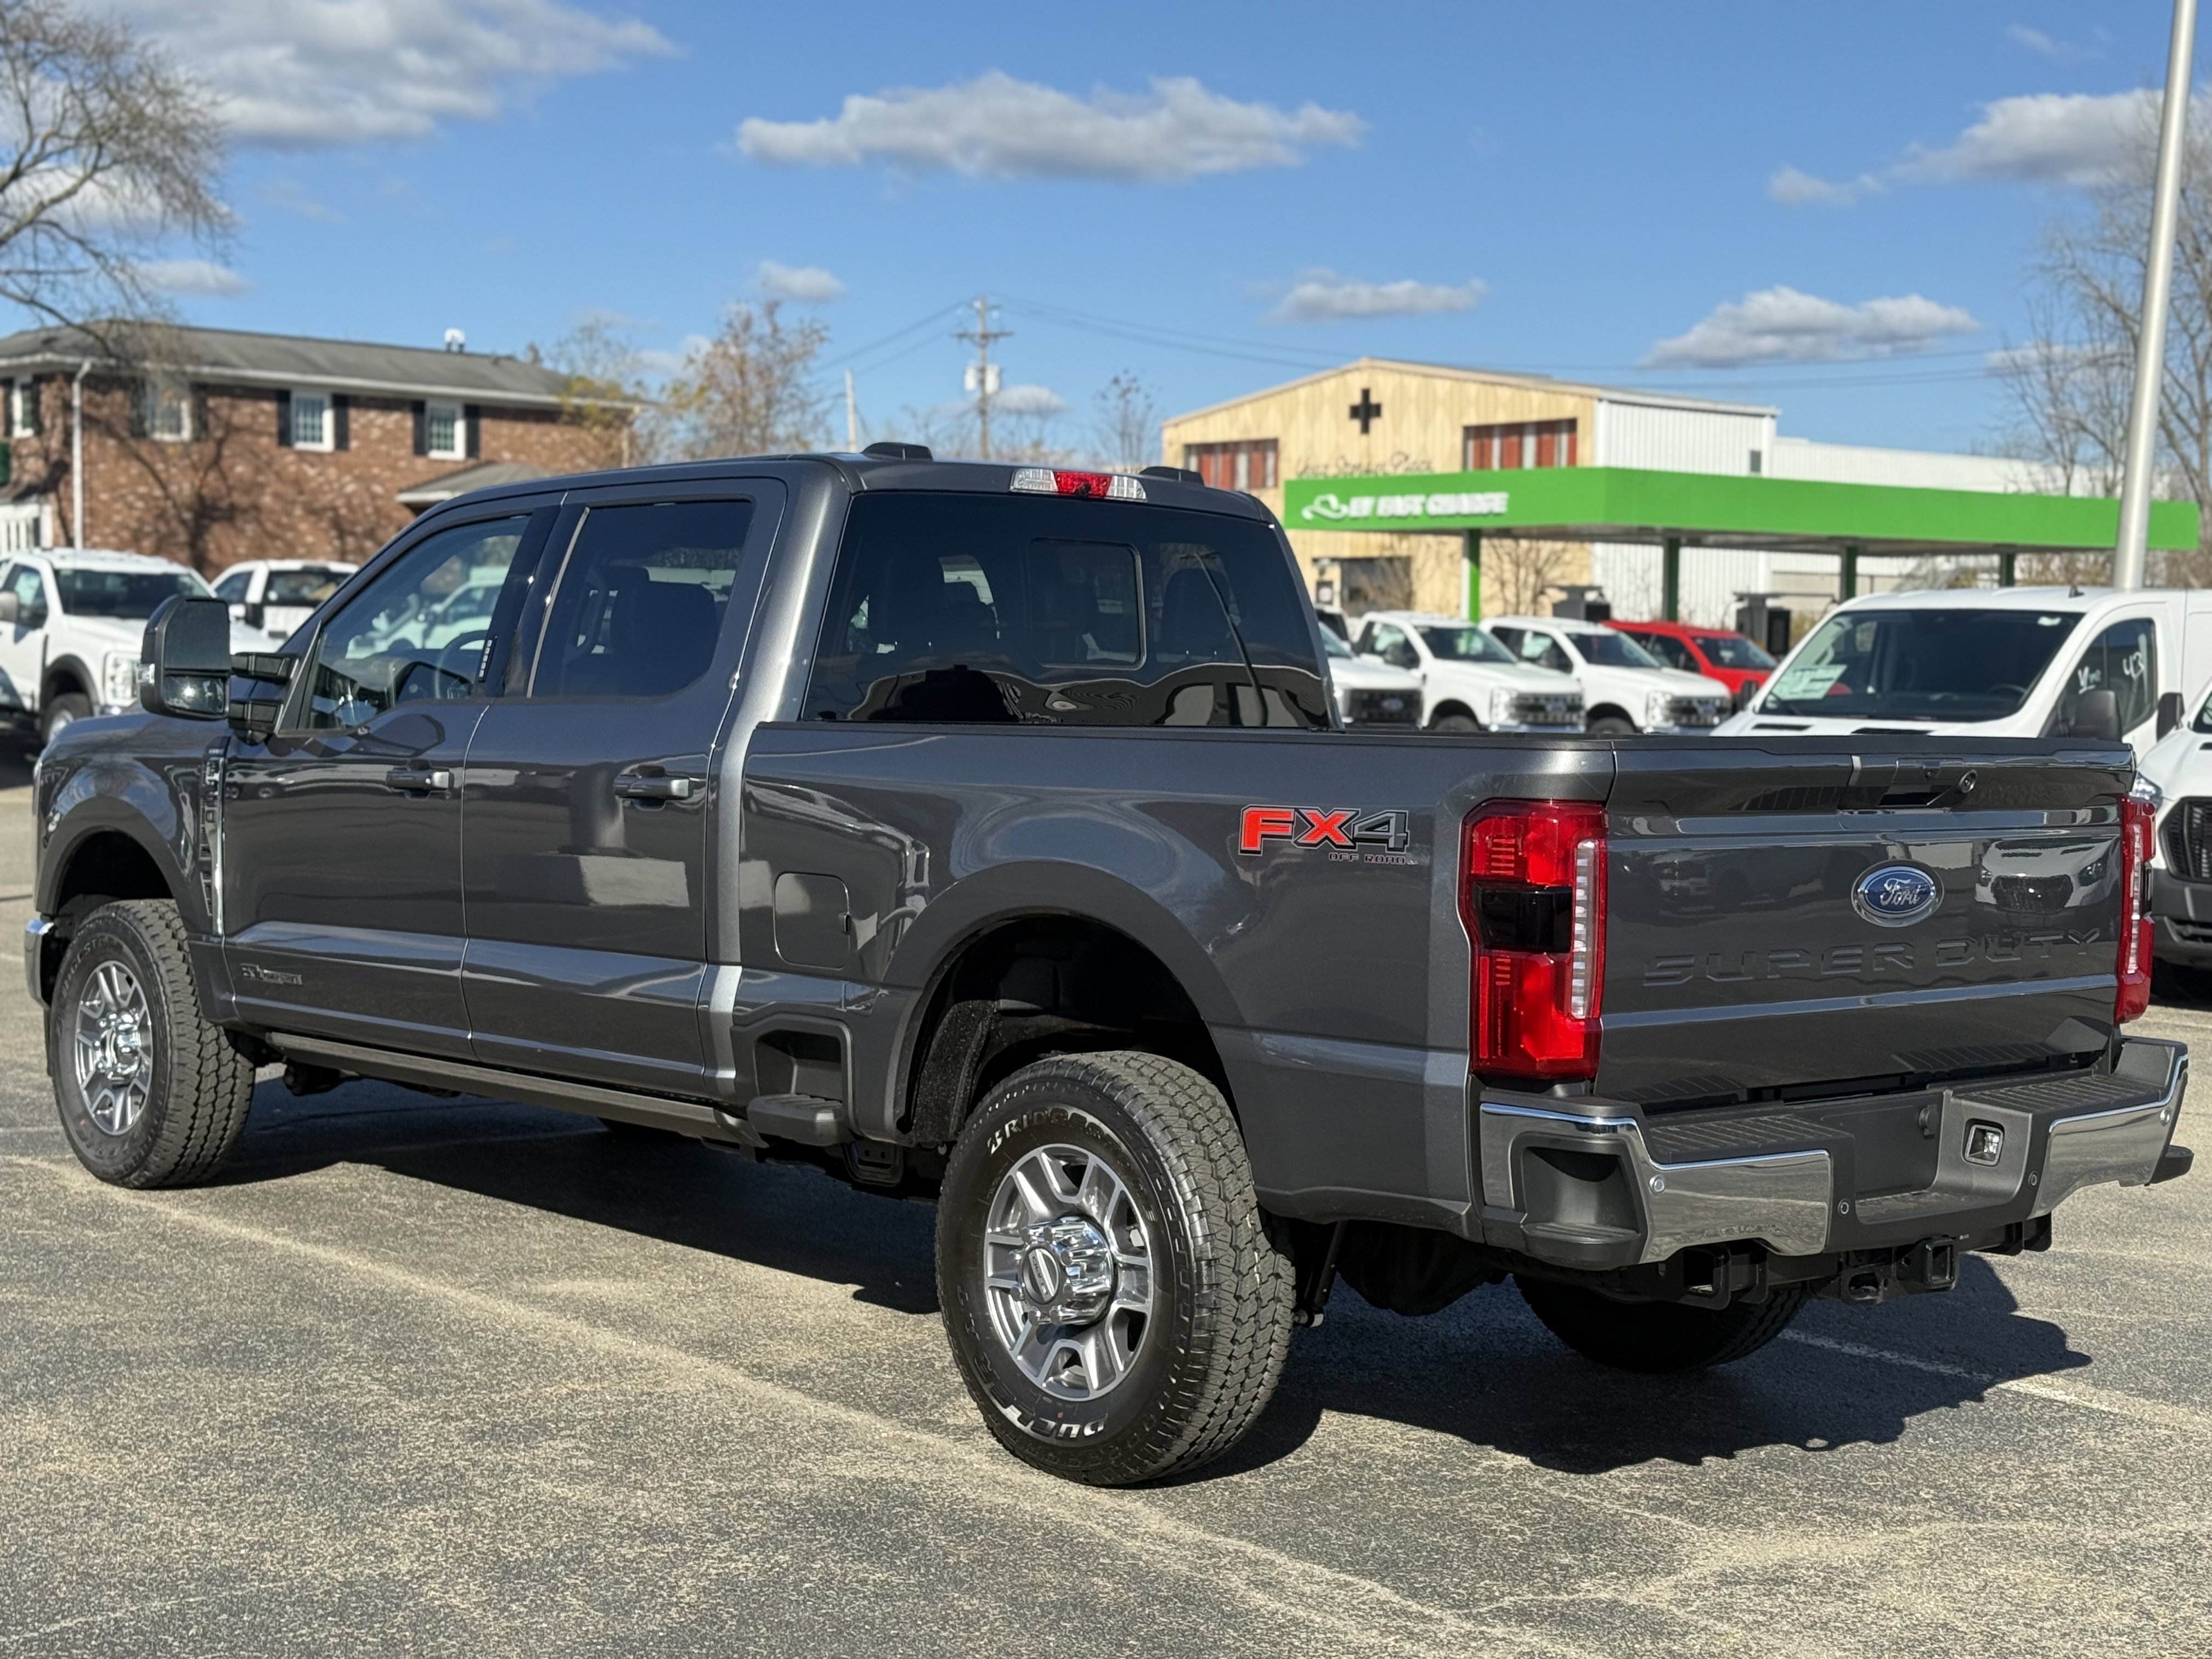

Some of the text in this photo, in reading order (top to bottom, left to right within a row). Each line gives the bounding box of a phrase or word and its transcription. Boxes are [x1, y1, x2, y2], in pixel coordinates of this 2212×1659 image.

[1238, 804, 1410, 856] FX4
[1329, 852, 1407, 865] OFF ROAD
[1880, 877, 1921, 906] Ford
[1643, 927, 2101, 986] SUPER DUTY
